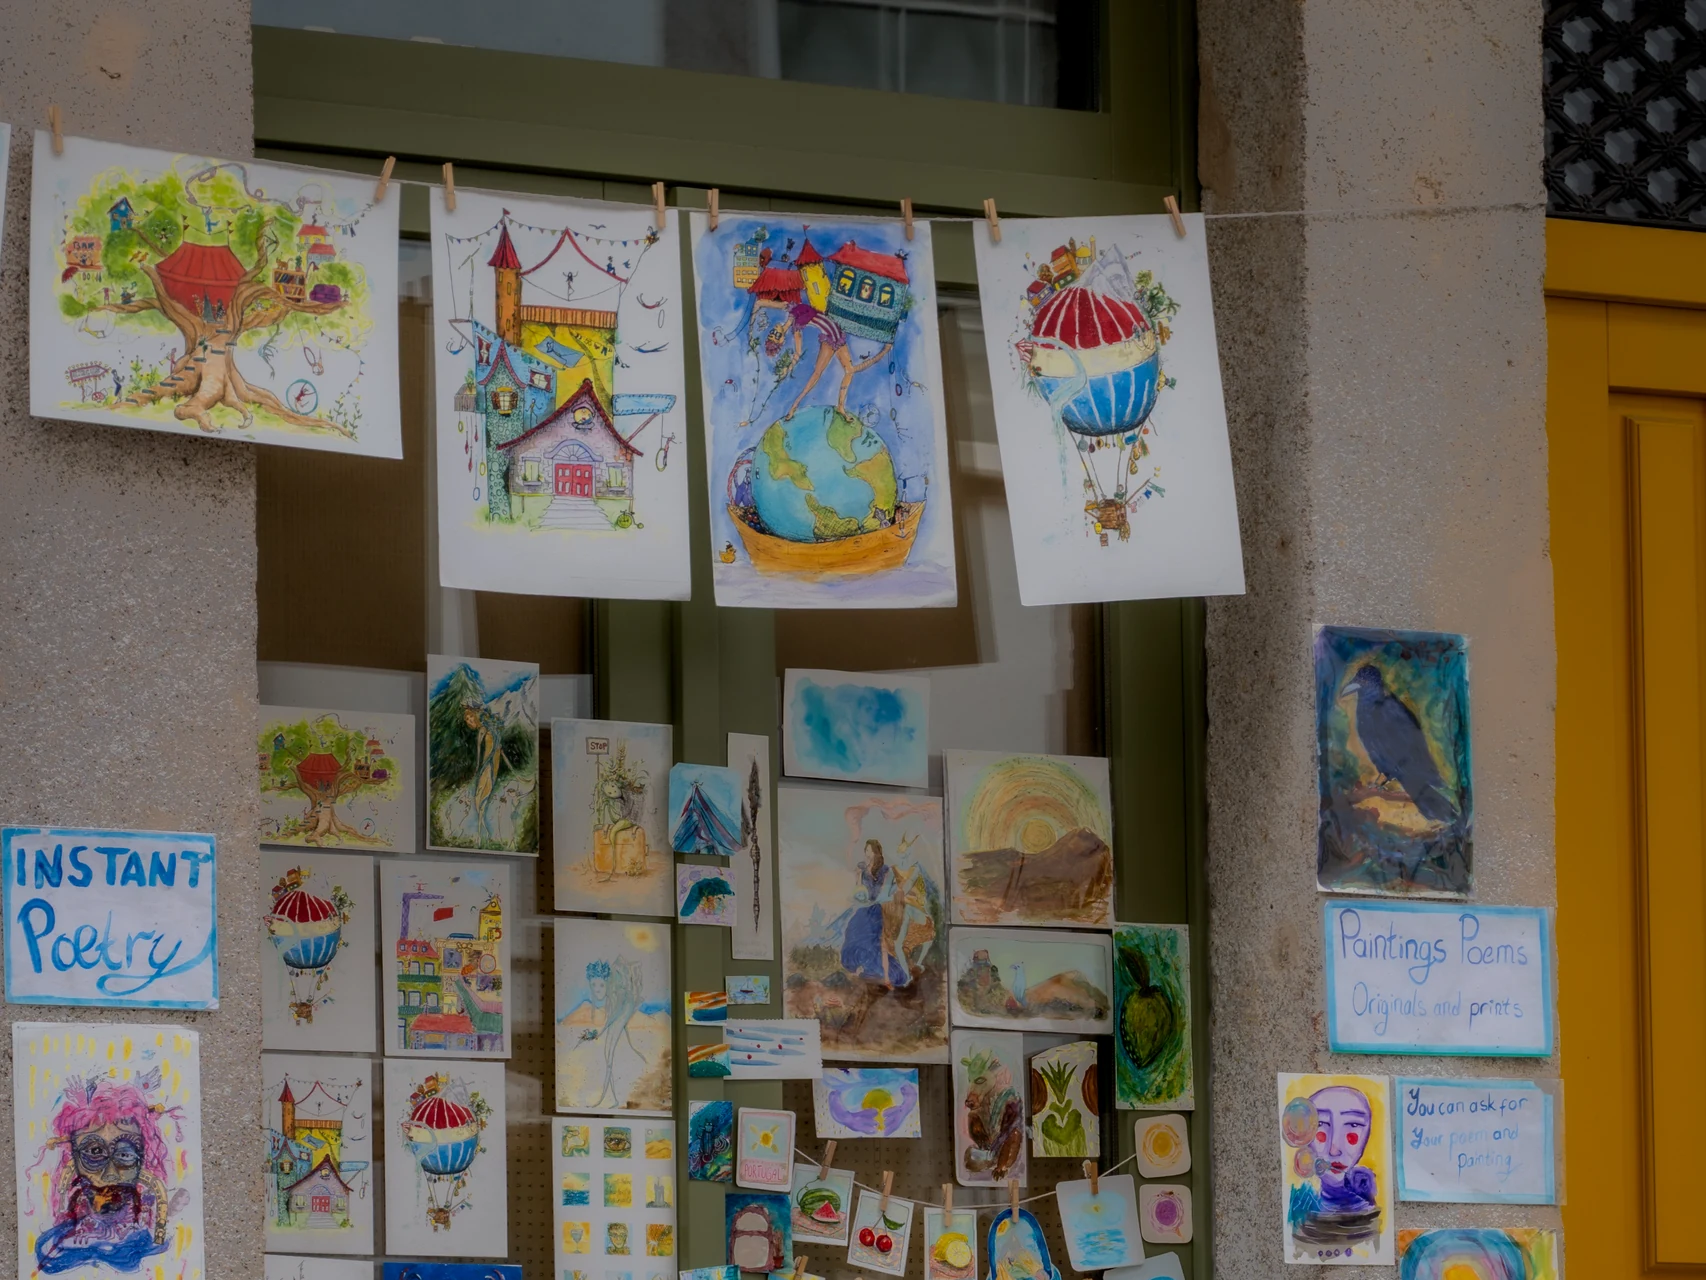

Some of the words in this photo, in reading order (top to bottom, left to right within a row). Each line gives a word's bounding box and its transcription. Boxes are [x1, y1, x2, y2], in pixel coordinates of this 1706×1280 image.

[590, 741, 607, 750] STOP
[16, 844, 212, 889] INSTANT
[17, 898, 212, 997] Poetry
[1339, 908, 1447, 985] Paintings
[1459, 913, 1528, 966] Poems
[1352, 982, 1427, 1036] Originals
[1433, 991, 1462, 1017] and
[1469, 997, 1524, 1031] prints
[1407, 1087, 1435, 1116] You
[1438, 1101, 1465, 1116] can
[1469, 1092, 1497, 1113] ask
[1499, 1097, 1529, 1117] for
[1492, 1123, 1519, 1141] and
[744, 1163, 783, 1181] PORTUGAL
